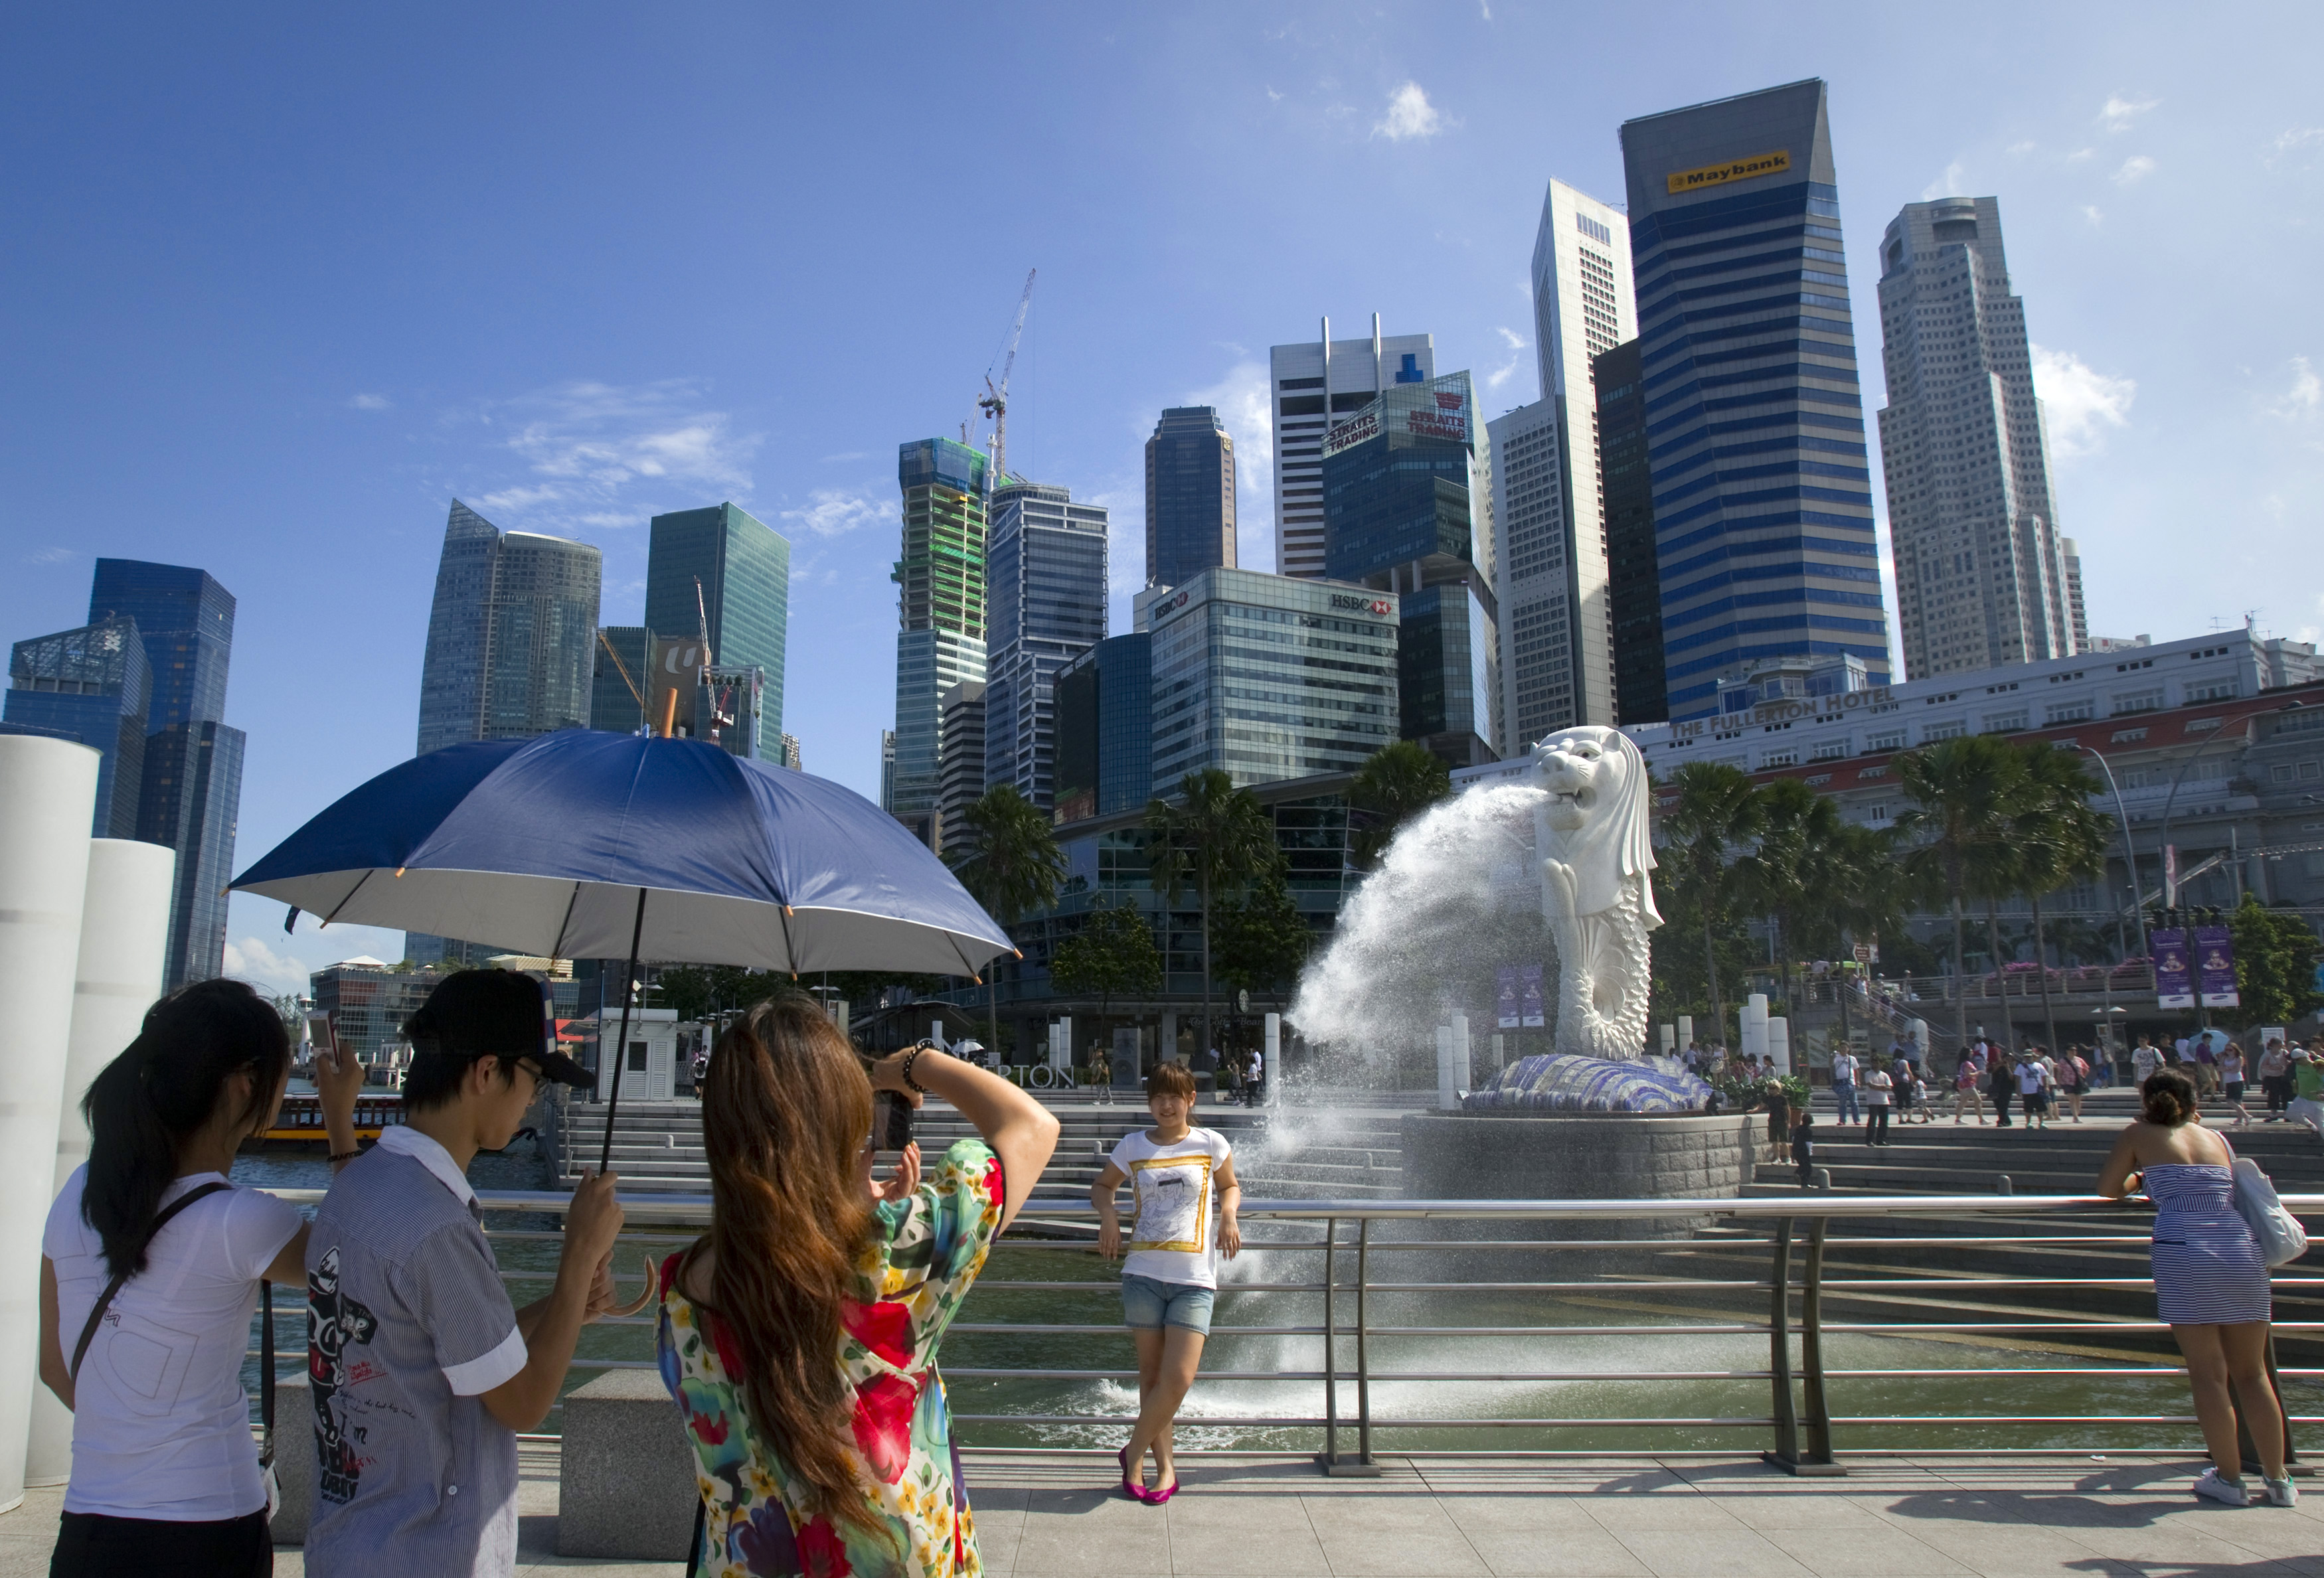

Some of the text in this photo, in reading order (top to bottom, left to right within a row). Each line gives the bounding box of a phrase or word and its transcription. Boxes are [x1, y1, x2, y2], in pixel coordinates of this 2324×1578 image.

[1687, 156, 1786, 185] Maybank
[1329, 413, 1376, 441] STRAITS
[1407, 422, 1465, 439] TRADING
[1409, 410, 1465, 428] STRAITS
[1329, 424, 1378, 452] TRADING
[1154, 597, 1177, 621] HSBC
[1331, 593, 1370, 611] HSBC
[1669, 686, 1896, 739] THE FULLERTON HOTEL
